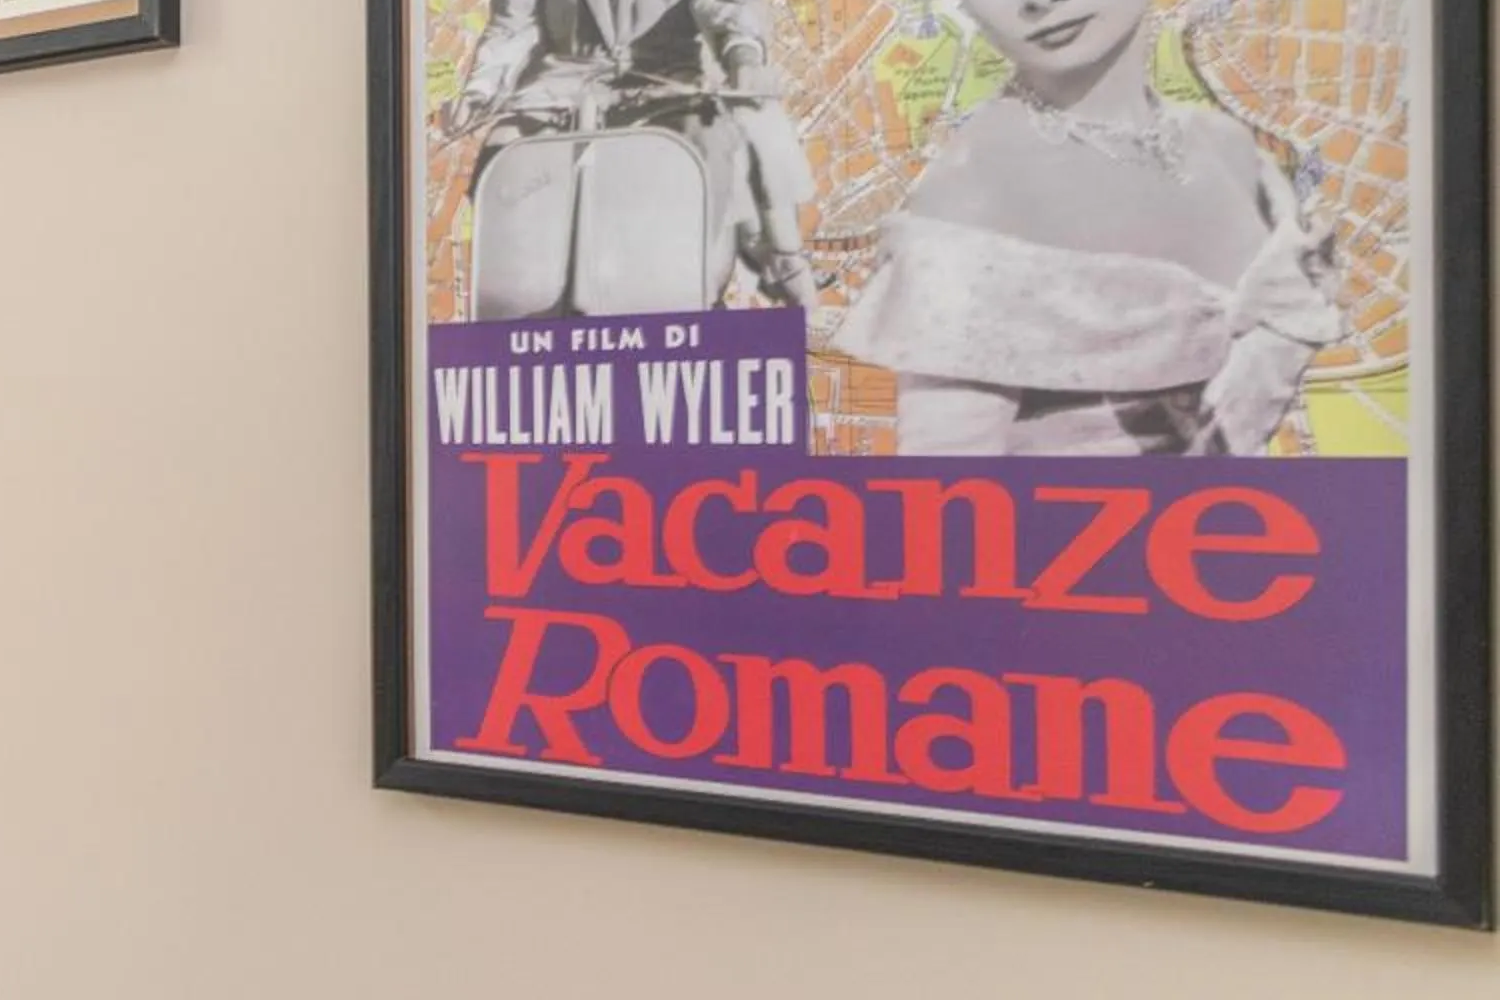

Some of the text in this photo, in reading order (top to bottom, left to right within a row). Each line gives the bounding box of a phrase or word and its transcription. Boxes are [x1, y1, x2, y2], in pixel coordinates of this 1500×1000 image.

[435, 358, 794, 445] WILLIAM WYLER
[511, 324, 699, 354] UN FILM DI
[460, 453, 1321, 622] Vacanze
[455, 605, 1348, 833] Romane
